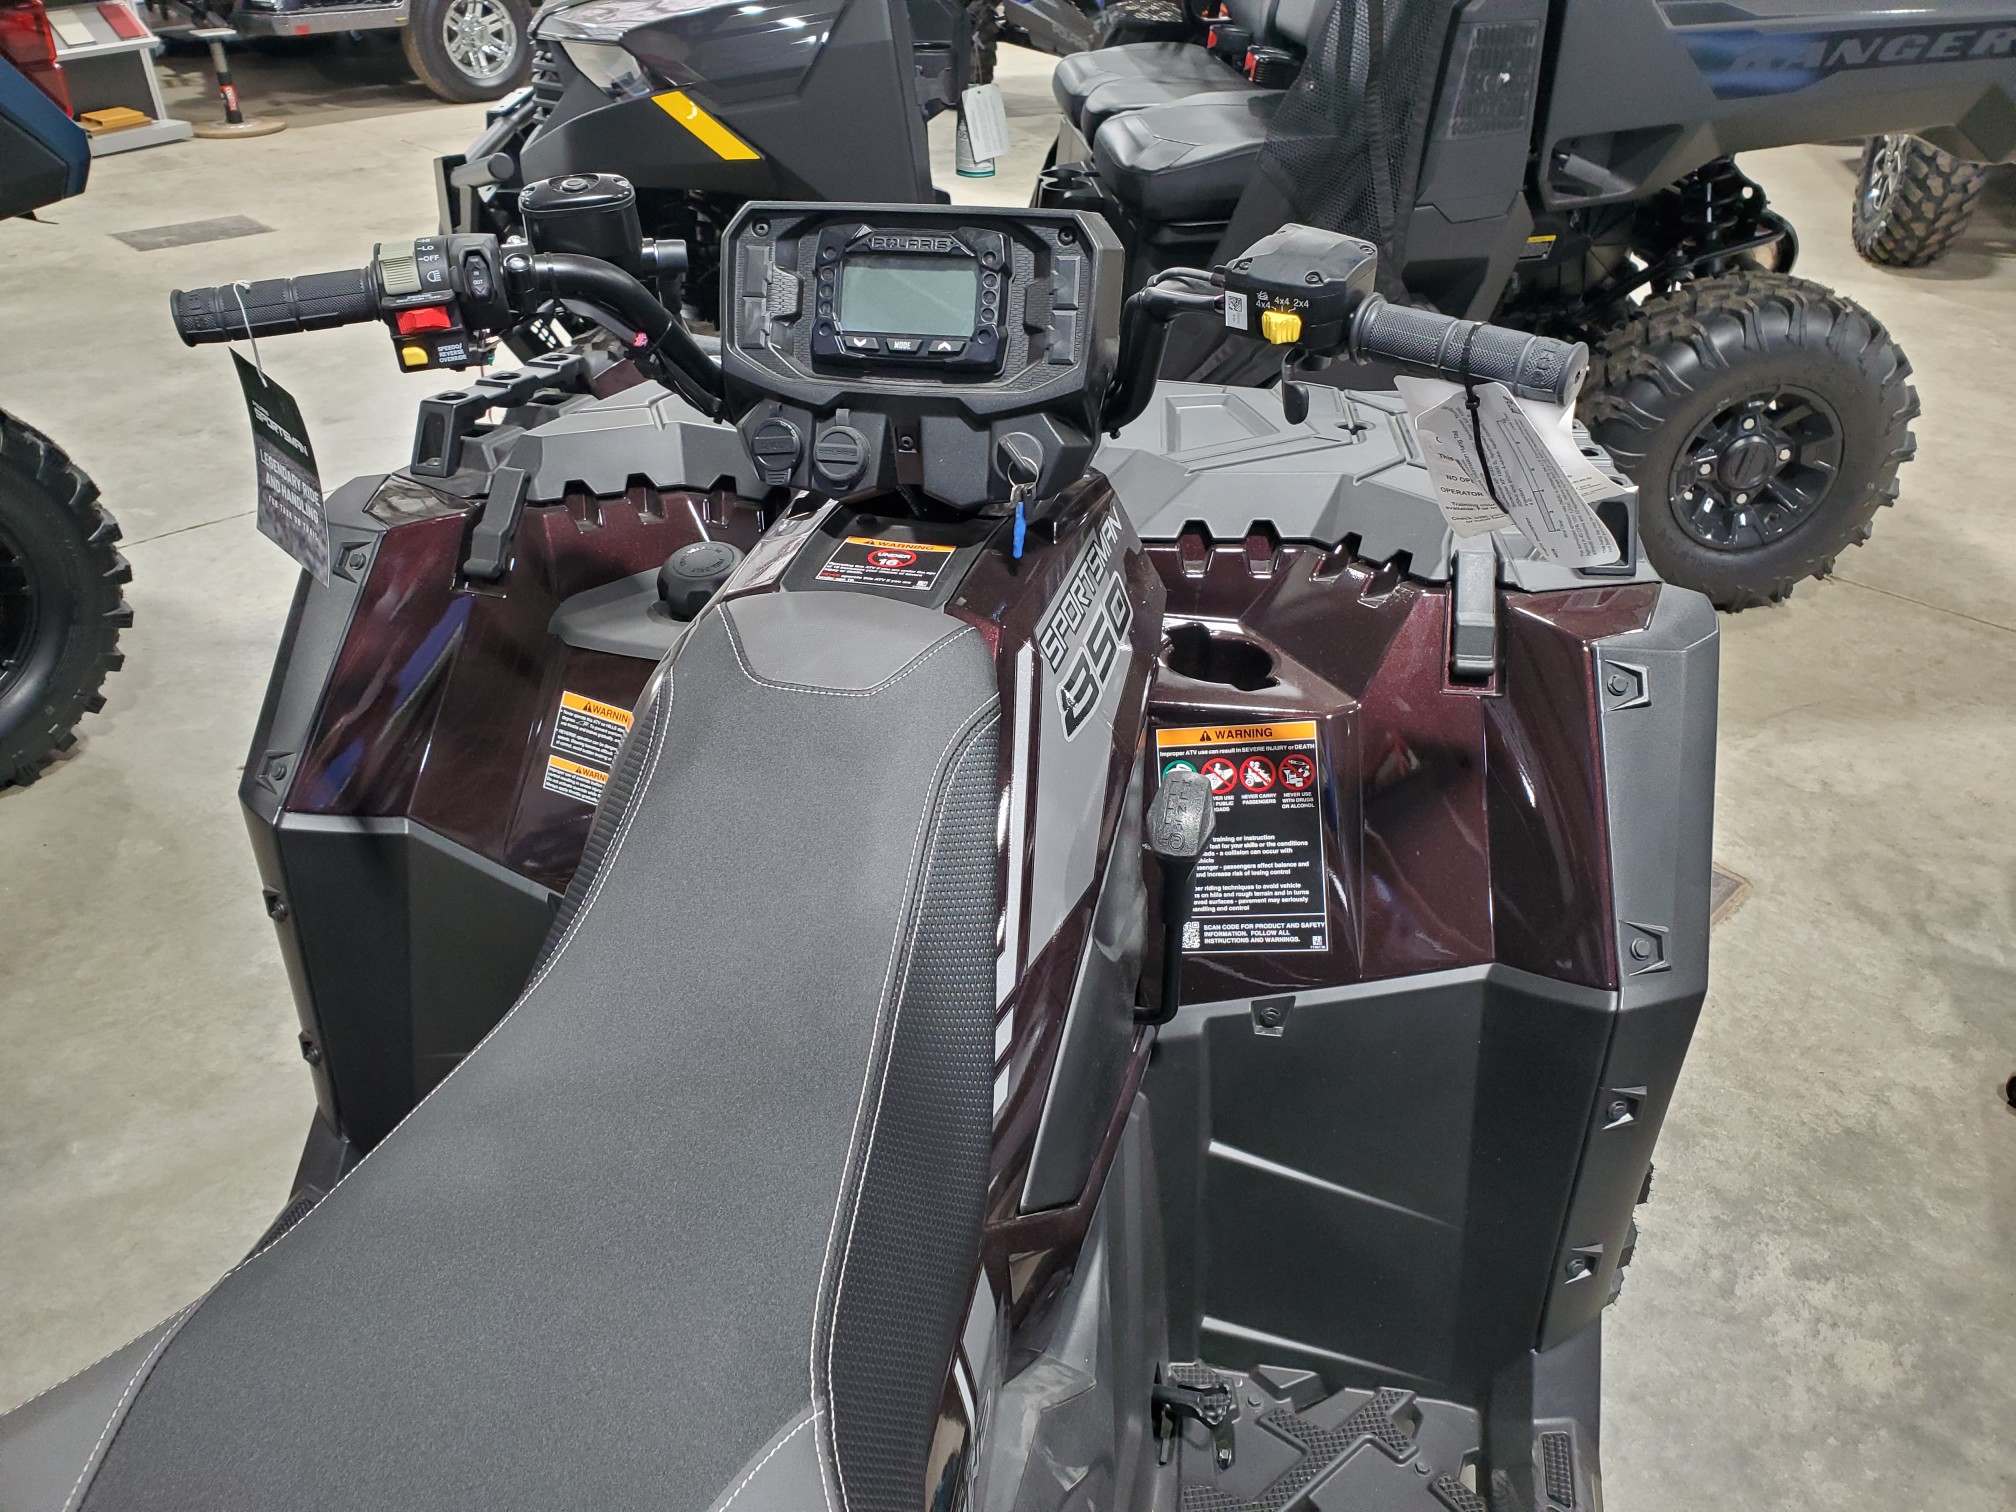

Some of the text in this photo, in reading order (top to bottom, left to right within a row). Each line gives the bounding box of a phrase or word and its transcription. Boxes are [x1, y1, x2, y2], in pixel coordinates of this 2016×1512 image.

[871, 236, 948, 250] POLARIS
[1256, 296, 1309, 309] 4x4 4x4 2x4
[894, 341, 911, 349] MODE
[254, 407, 308, 457] SPORTSMAN
[260, 449, 320, 507] LEGENDARY RIDE
[266, 472, 318, 524] AND HANDLING
[1441, 487, 1484, 496] OPERATOR
[878, 542, 934, 550] WARNING
[878, 552, 911, 560] UNDER
[1039, 505, 1122, 674] SPORTSMAN
[1215, 728, 1272, 740] WARNING
